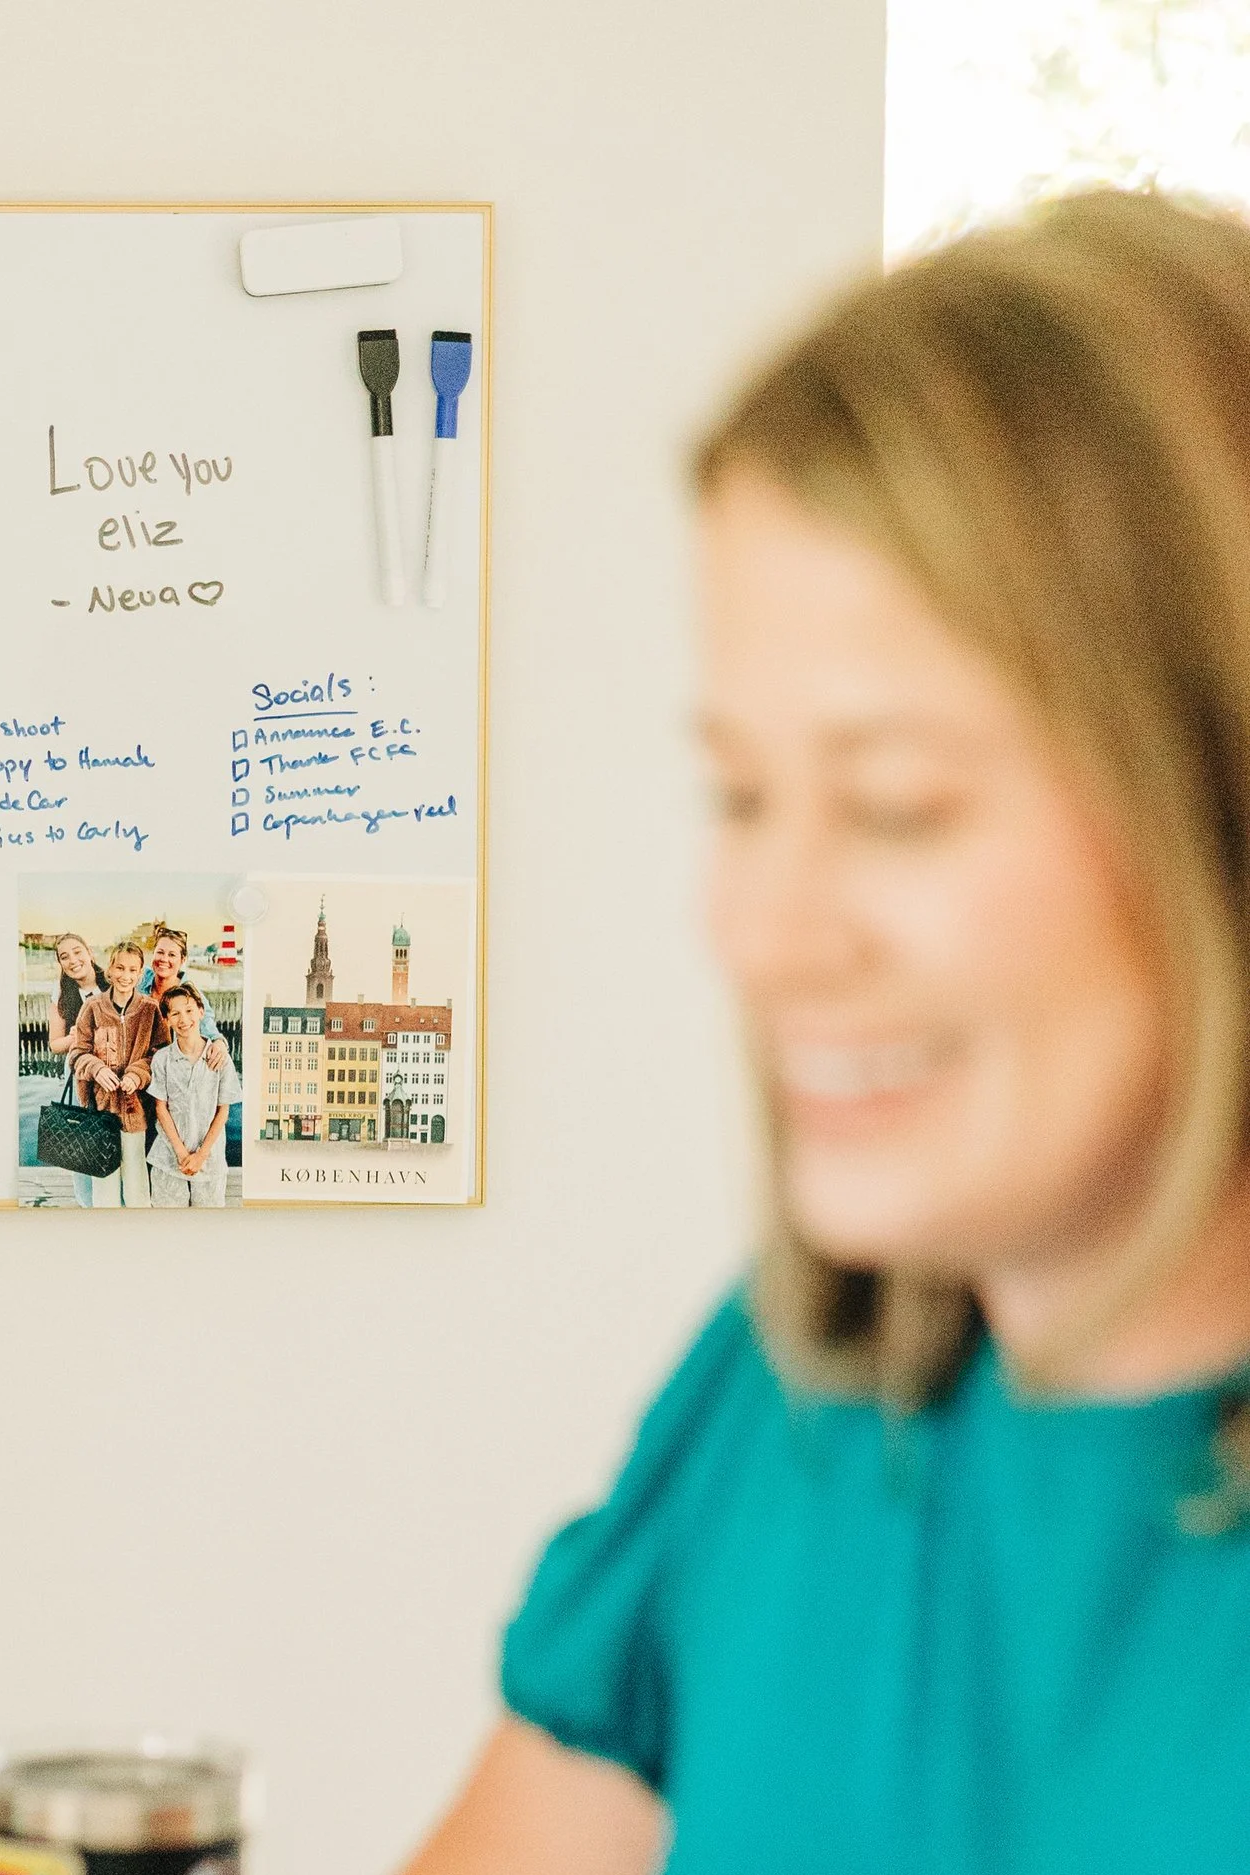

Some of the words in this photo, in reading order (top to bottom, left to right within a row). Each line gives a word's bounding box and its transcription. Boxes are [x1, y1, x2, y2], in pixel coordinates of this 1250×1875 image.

[48, 424, 158, 497] Love
[98, 509, 184, 551] eliz
[370, 718, 421, 739] E.C.
[44, 750, 68, 772] to
[265, 784, 361, 804] Summer
[45, 824, 65, 844] to
[262, 808, 410, 841] Copenhagen
[280, 1167, 428, 1185] KØBENHAVN
